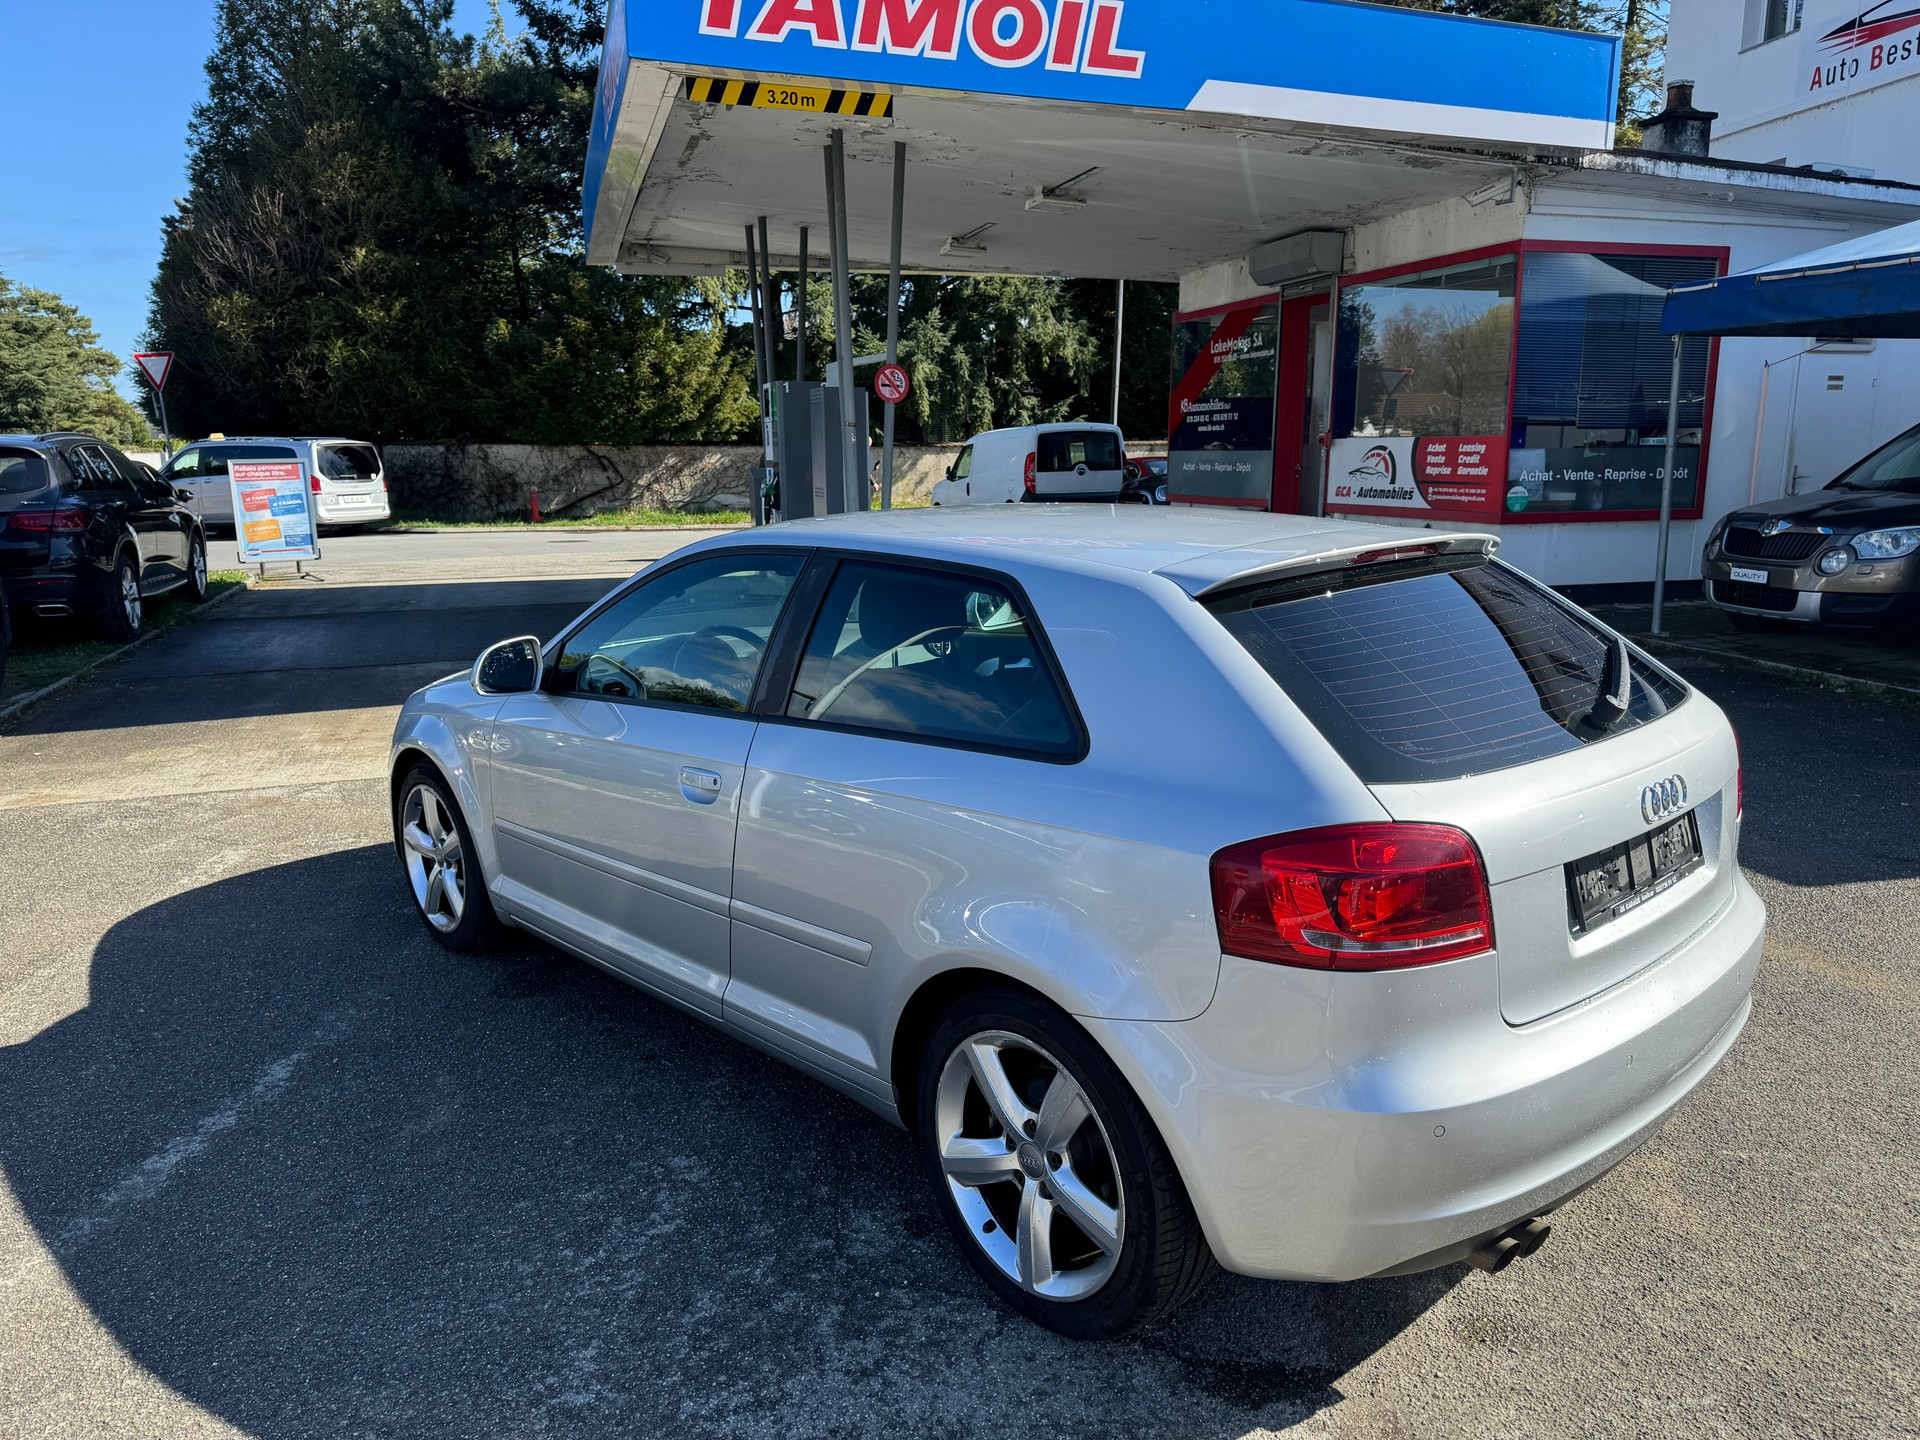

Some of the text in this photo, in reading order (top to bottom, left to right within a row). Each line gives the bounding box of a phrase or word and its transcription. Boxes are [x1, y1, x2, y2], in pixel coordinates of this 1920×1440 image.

[1809, 32, 1920, 92] Auto Best
[767, 89, 815, 107] 3.20 m
[1210, 331, 1263, 354] LakeMotors SA
[783, 381, 790, 393] 1
[1426, 443, 1447, 452] Achat
[1458, 443, 1486, 454] Leasing
[1426, 455, 1446, 464] Vente
[257, 464, 292, 472] permanent
[1183, 462, 1196, 471] Achat
[1198, 462, 1211, 471] Vente
[1215, 462, 1233, 474] Reprise
[1236, 462, 1252, 474] Dépôt
[1425, 466, 1452, 476] Reprise
[1457, 466, 1488, 476] Garantie
[246, 470, 271, 478] chaque
[1519, 470, 1553, 482] Achat
[1563, 469, 1595, 481] Vente
[1604, 468, 1647, 483] Reprise
[1655, 467, 1688, 481] Dôt
[1335, 486, 1352, 497] GCA
[1356, 486, 1415, 501] Automobiles
[278, 499, 303, 507] TAMOIL
[1733, 571, 1761, 580] QUALITY
